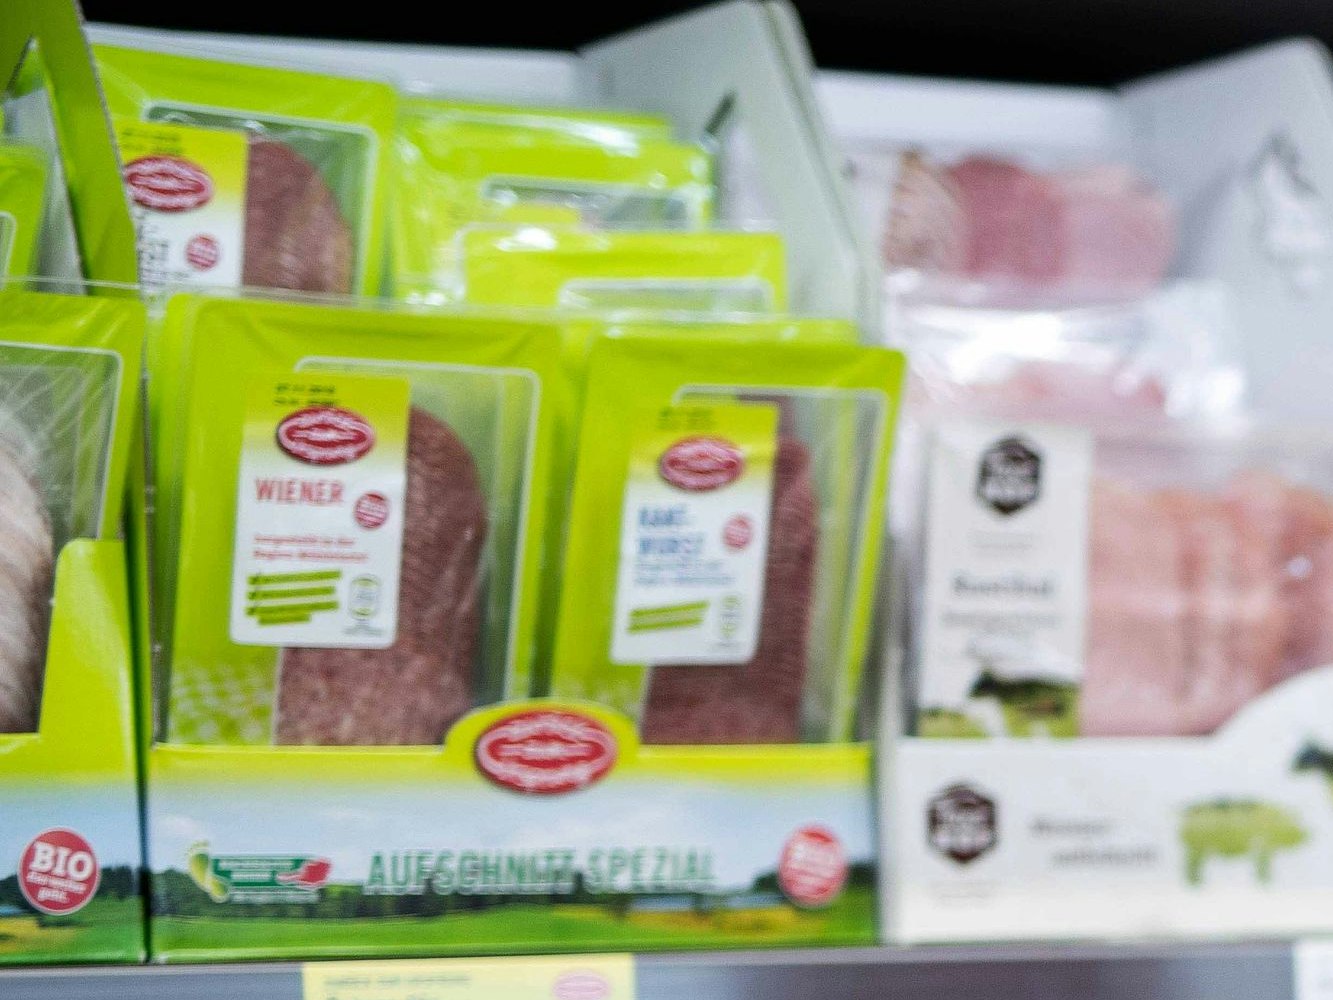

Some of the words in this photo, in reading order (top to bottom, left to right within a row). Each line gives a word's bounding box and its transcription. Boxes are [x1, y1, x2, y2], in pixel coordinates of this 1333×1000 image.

[255, 478, 345, 505] WIENER
[29, 839, 94, 881] BIO
[363, 849, 577, 896] AUFSCHNITT
[583, 847, 717, 894] SPEZIAL
